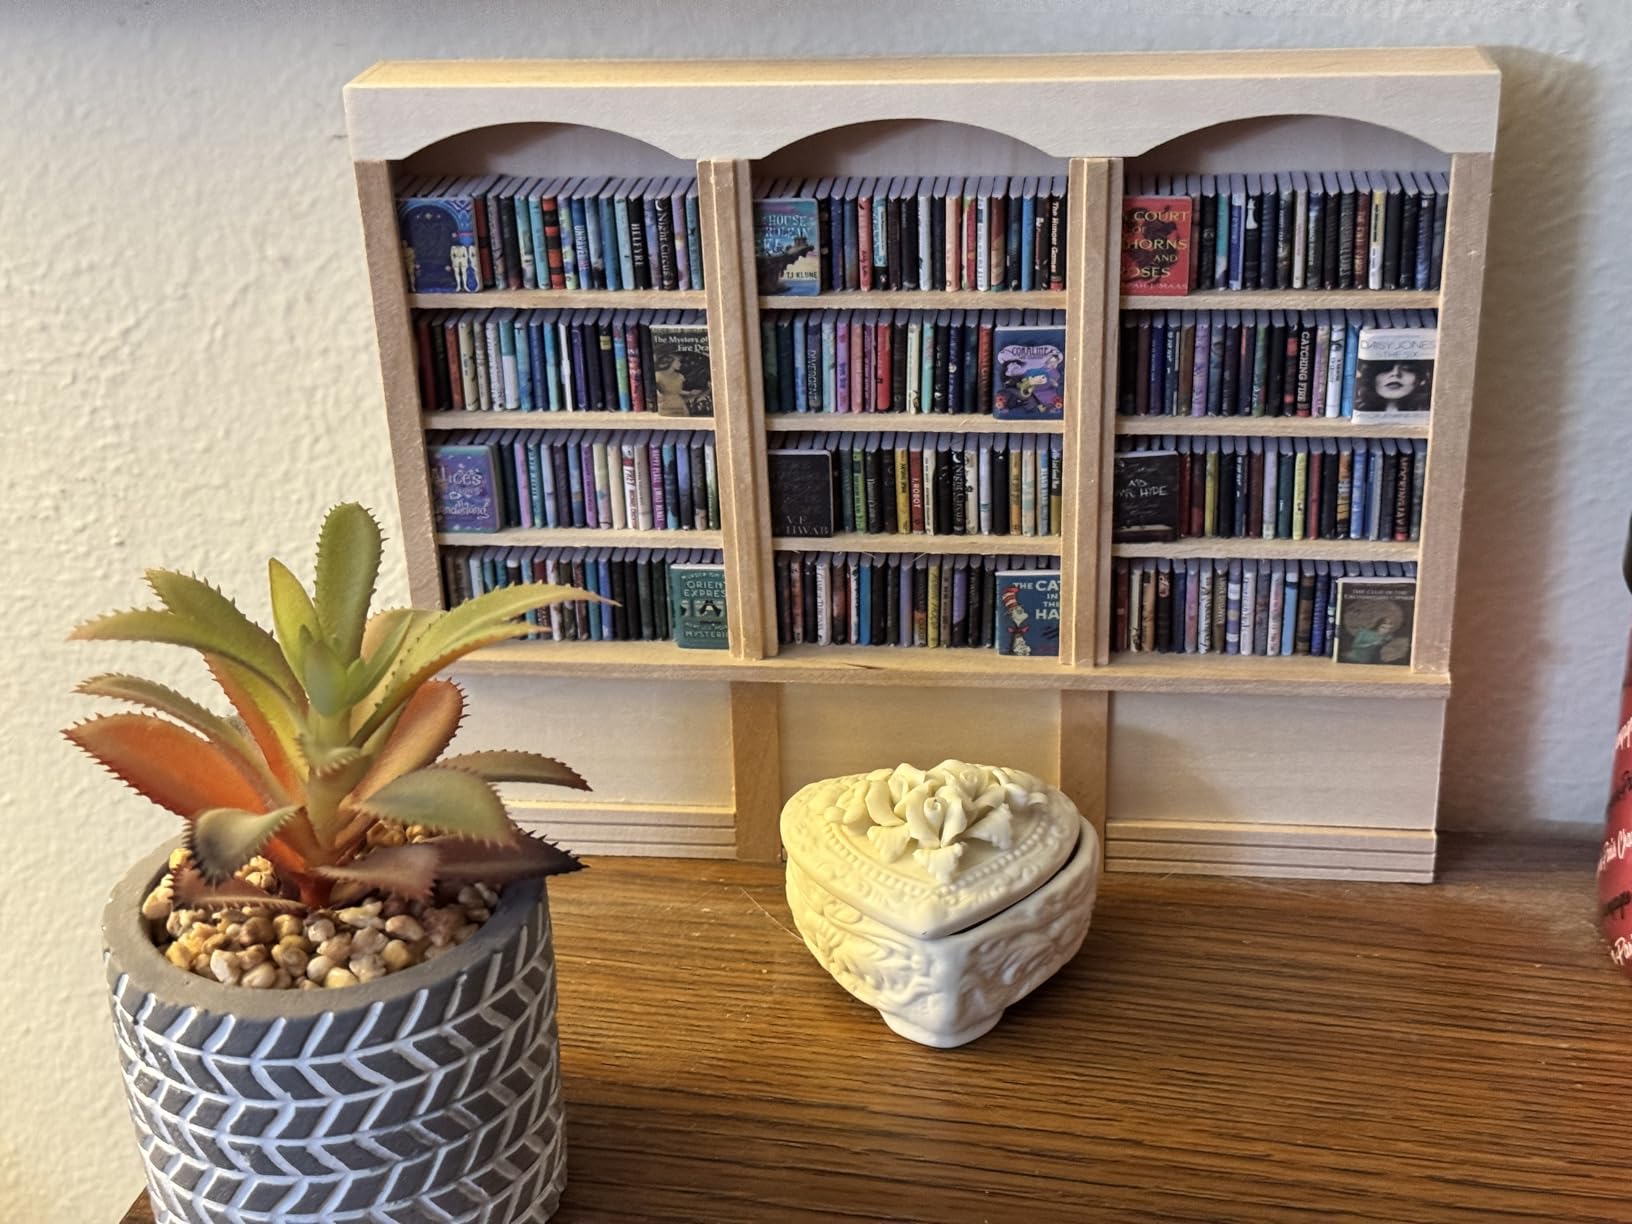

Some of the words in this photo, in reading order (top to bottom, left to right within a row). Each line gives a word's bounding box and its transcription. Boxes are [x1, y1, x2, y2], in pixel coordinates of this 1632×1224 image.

[769, 214, 807, 227] HOUSE
[1051, 202, 1059, 216] The
[1134, 211, 1189, 222] COURT
[657, 212, 668, 241] Night
[1051, 217, 1059, 245] Hunger
[575, 225, 587, 258] UNRAVEL
[660, 243, 671, 277] Circus
[1154, 254, 1178, 262] AND
[669, 336, 699, 345] Mystery
[700, 335, 708, 343] of
[1012, 347, 1048, 356] CORALINE
[1298, 331, 1309, 380] CATCHING
[807, 350, 817, 401] DIVERGENT
[1297, 382, 1306, 402] FIRE
[953, 464, 964, 490] Night
[912, 484, 920, 508] ROBOT
[1140, 486, 1169, 497] HYDE
[1395, 457, 1409, 526] MOCKINGJAY
[955, 493, 964, 522] Circus
[1013, 582, 1033, 590] THE
